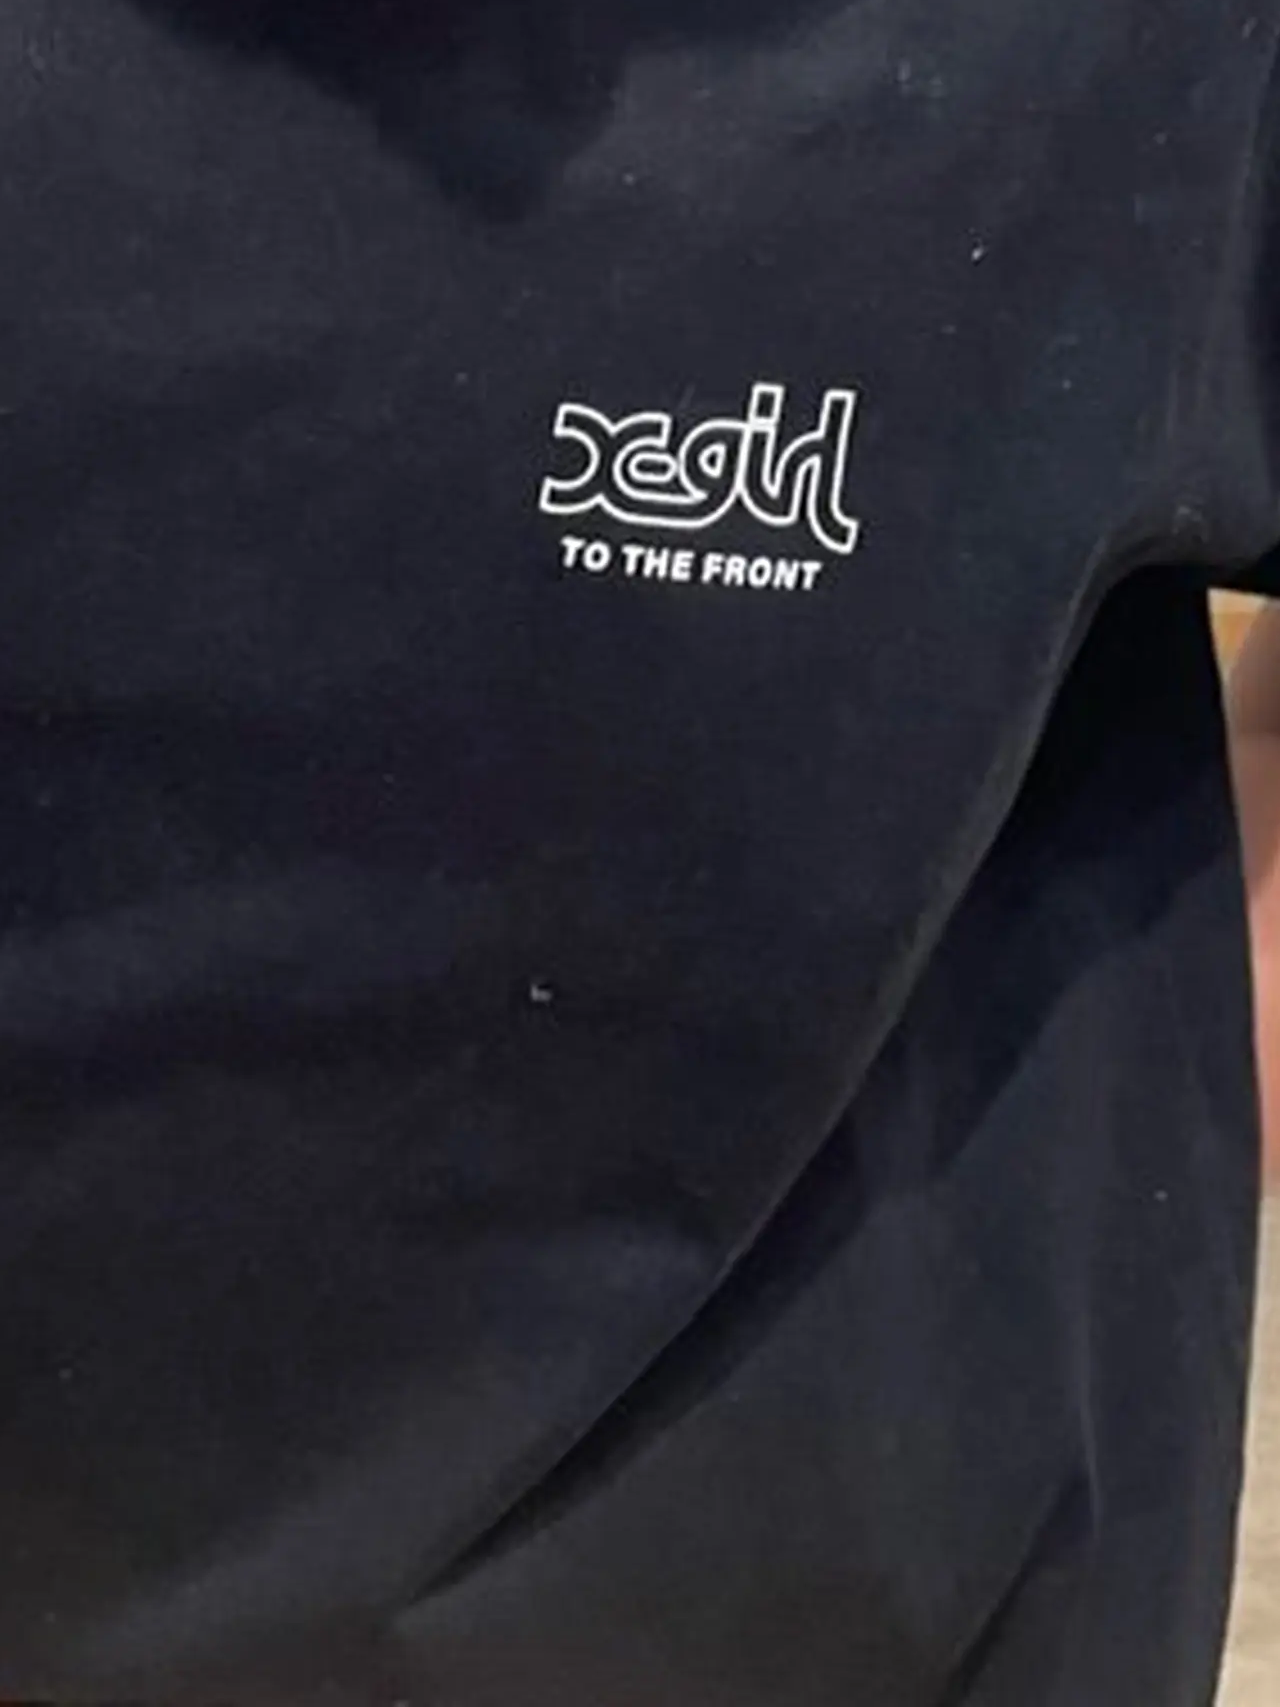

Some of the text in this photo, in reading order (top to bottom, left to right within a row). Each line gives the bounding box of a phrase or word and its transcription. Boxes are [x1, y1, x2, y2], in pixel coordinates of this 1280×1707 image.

[561, 536, 822, 590] TO THE FRONT
